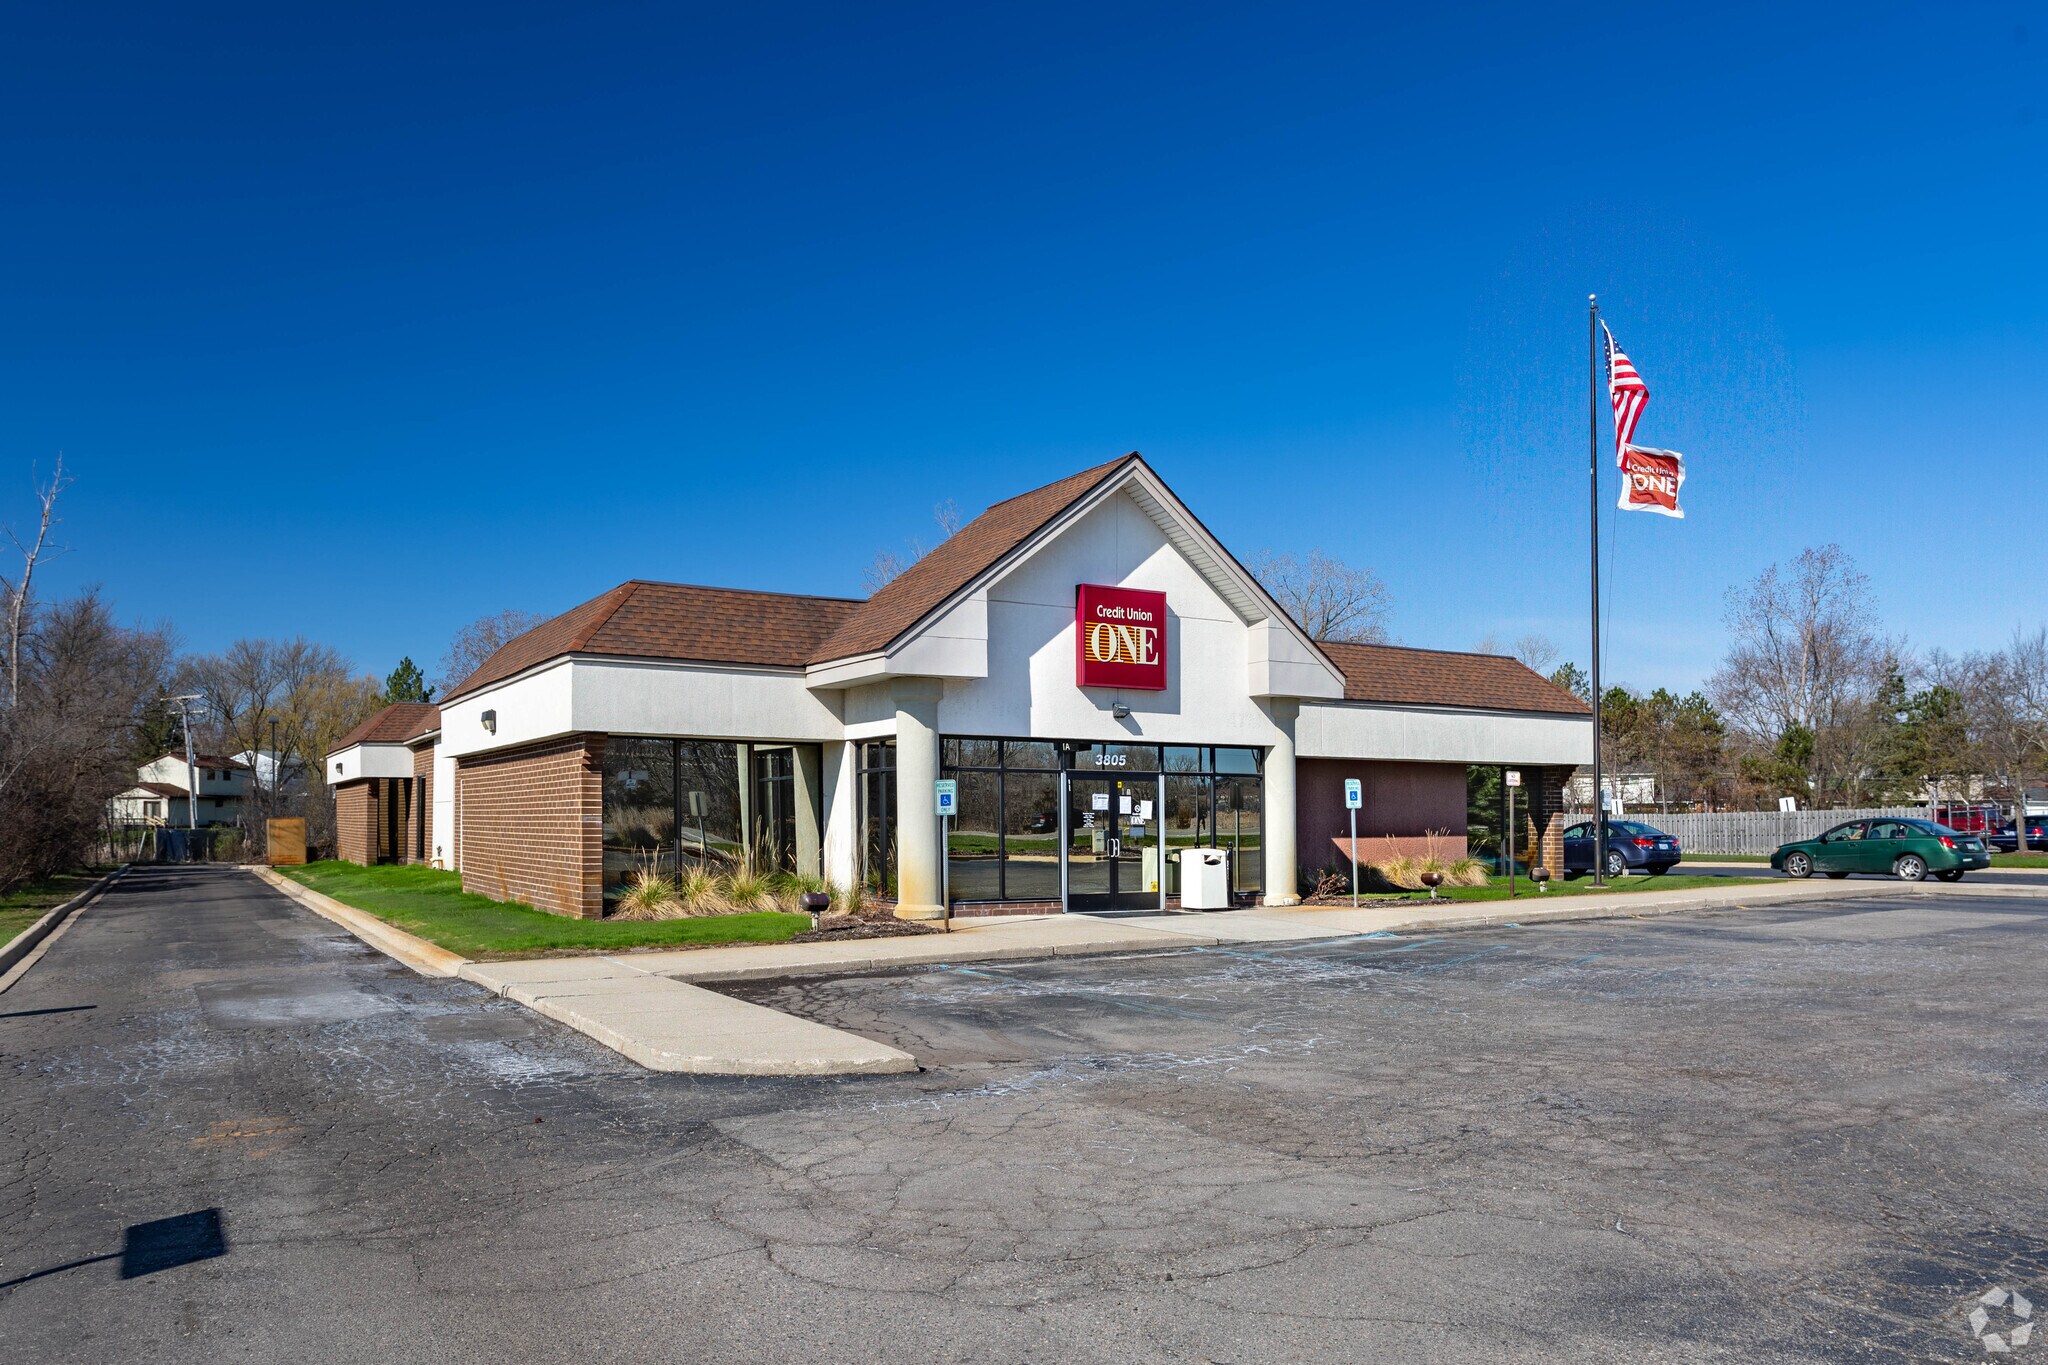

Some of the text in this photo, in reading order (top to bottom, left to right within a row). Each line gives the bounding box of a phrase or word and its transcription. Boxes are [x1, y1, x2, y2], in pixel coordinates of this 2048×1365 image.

[1632, 464, 1655, 473] Credit
[1632, 473, 1676, 497] ONE
[1097, 605, 1153, 621] Credit Union
[1091, 623, 1159, 665] ONE
[1095, 754, 1127, 766] 3805
